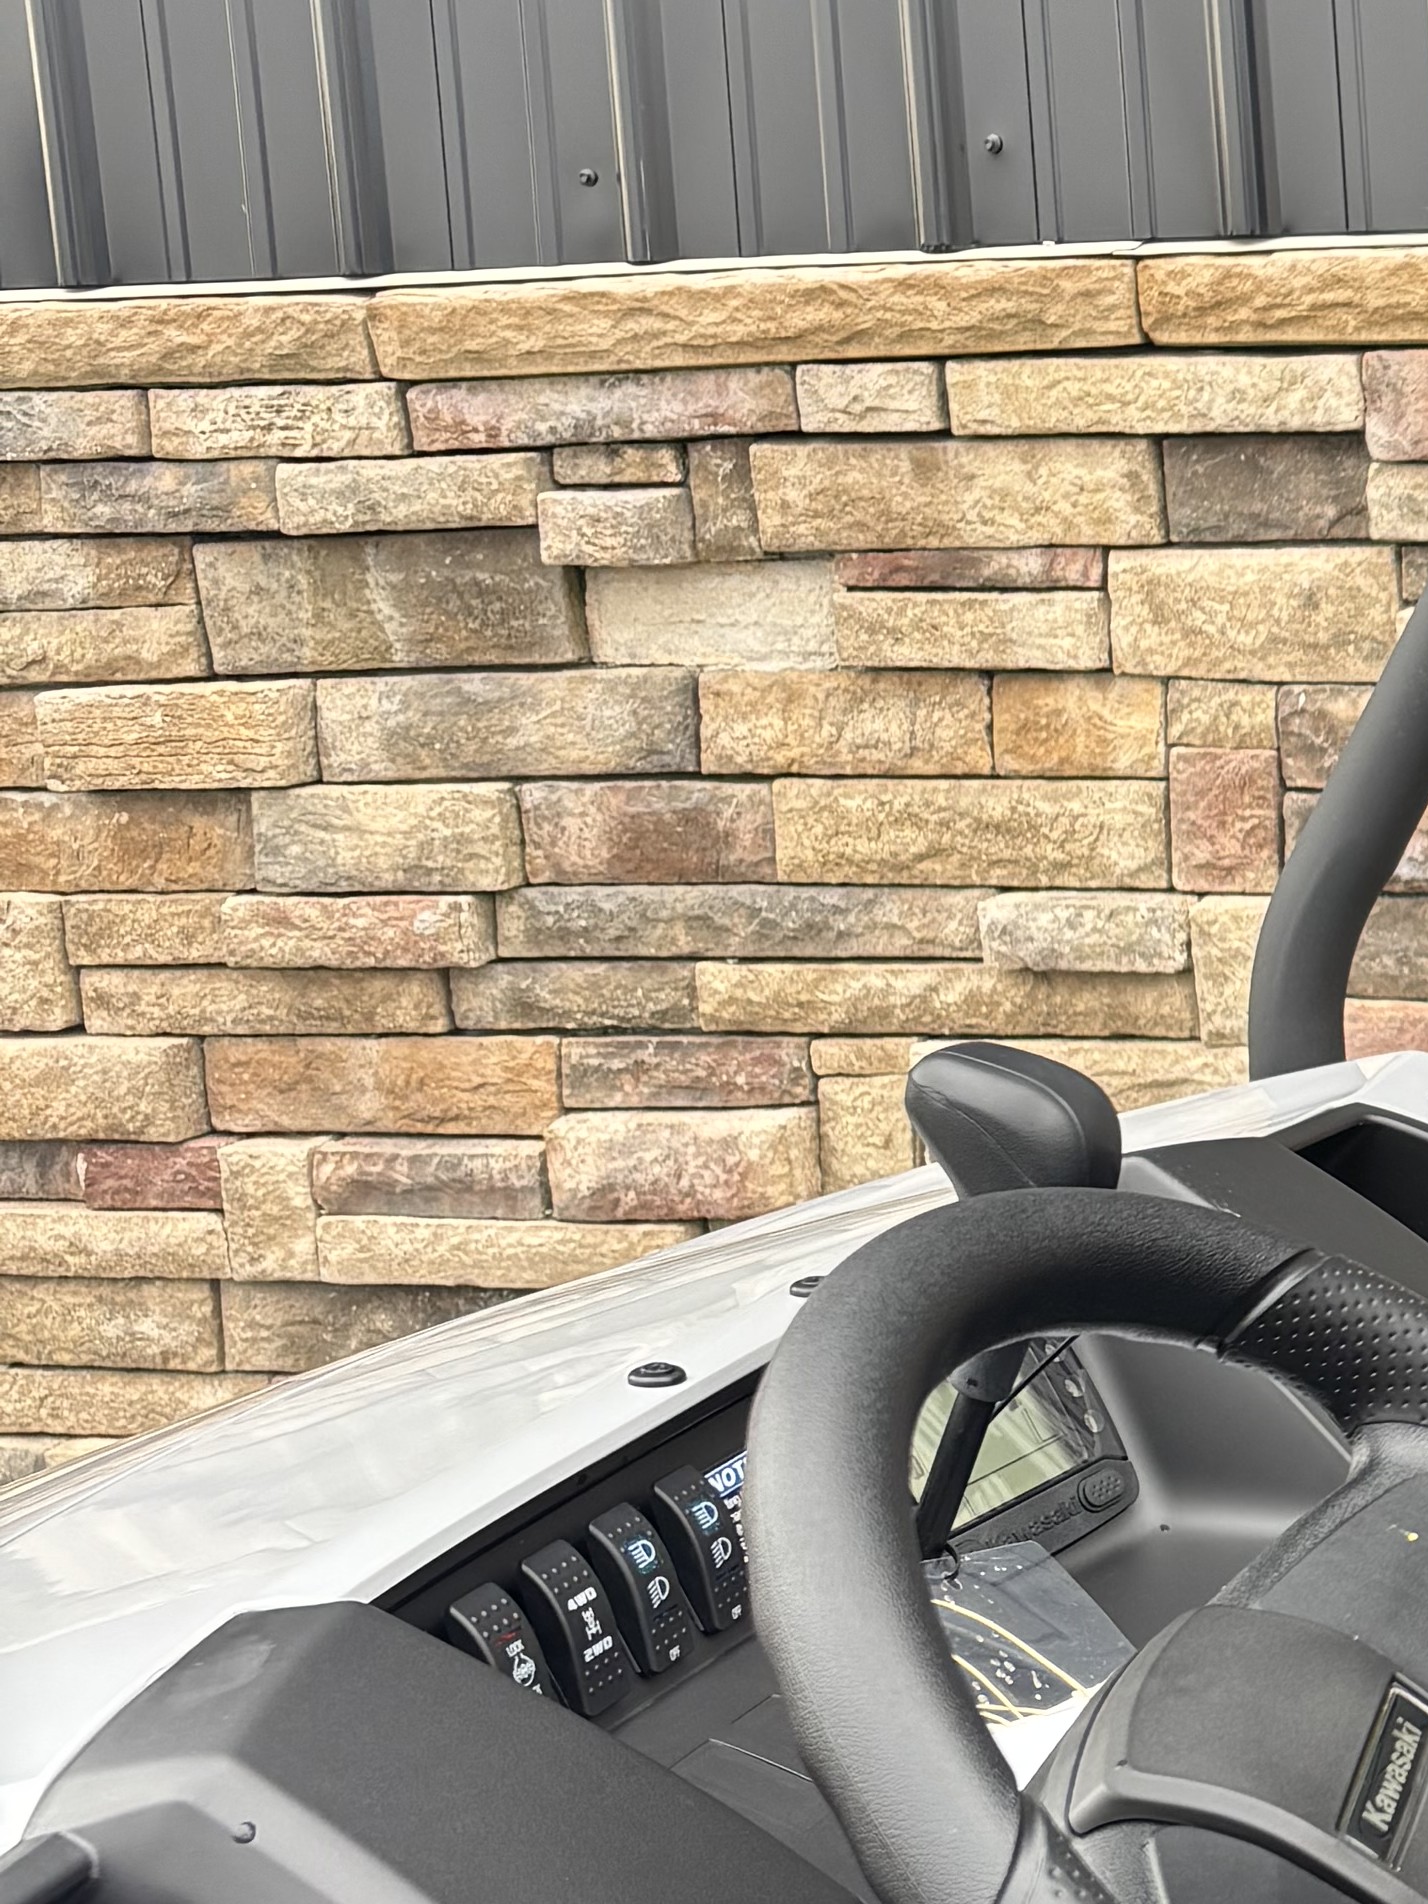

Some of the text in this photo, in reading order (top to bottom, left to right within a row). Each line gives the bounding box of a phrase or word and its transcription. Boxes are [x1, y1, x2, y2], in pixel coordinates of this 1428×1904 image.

[567, 1586, 597, 1611] 4WD
[583, 1636, 613, 1663] 2WD
[1362, 1716, 1422, 1833] Kawasaki
